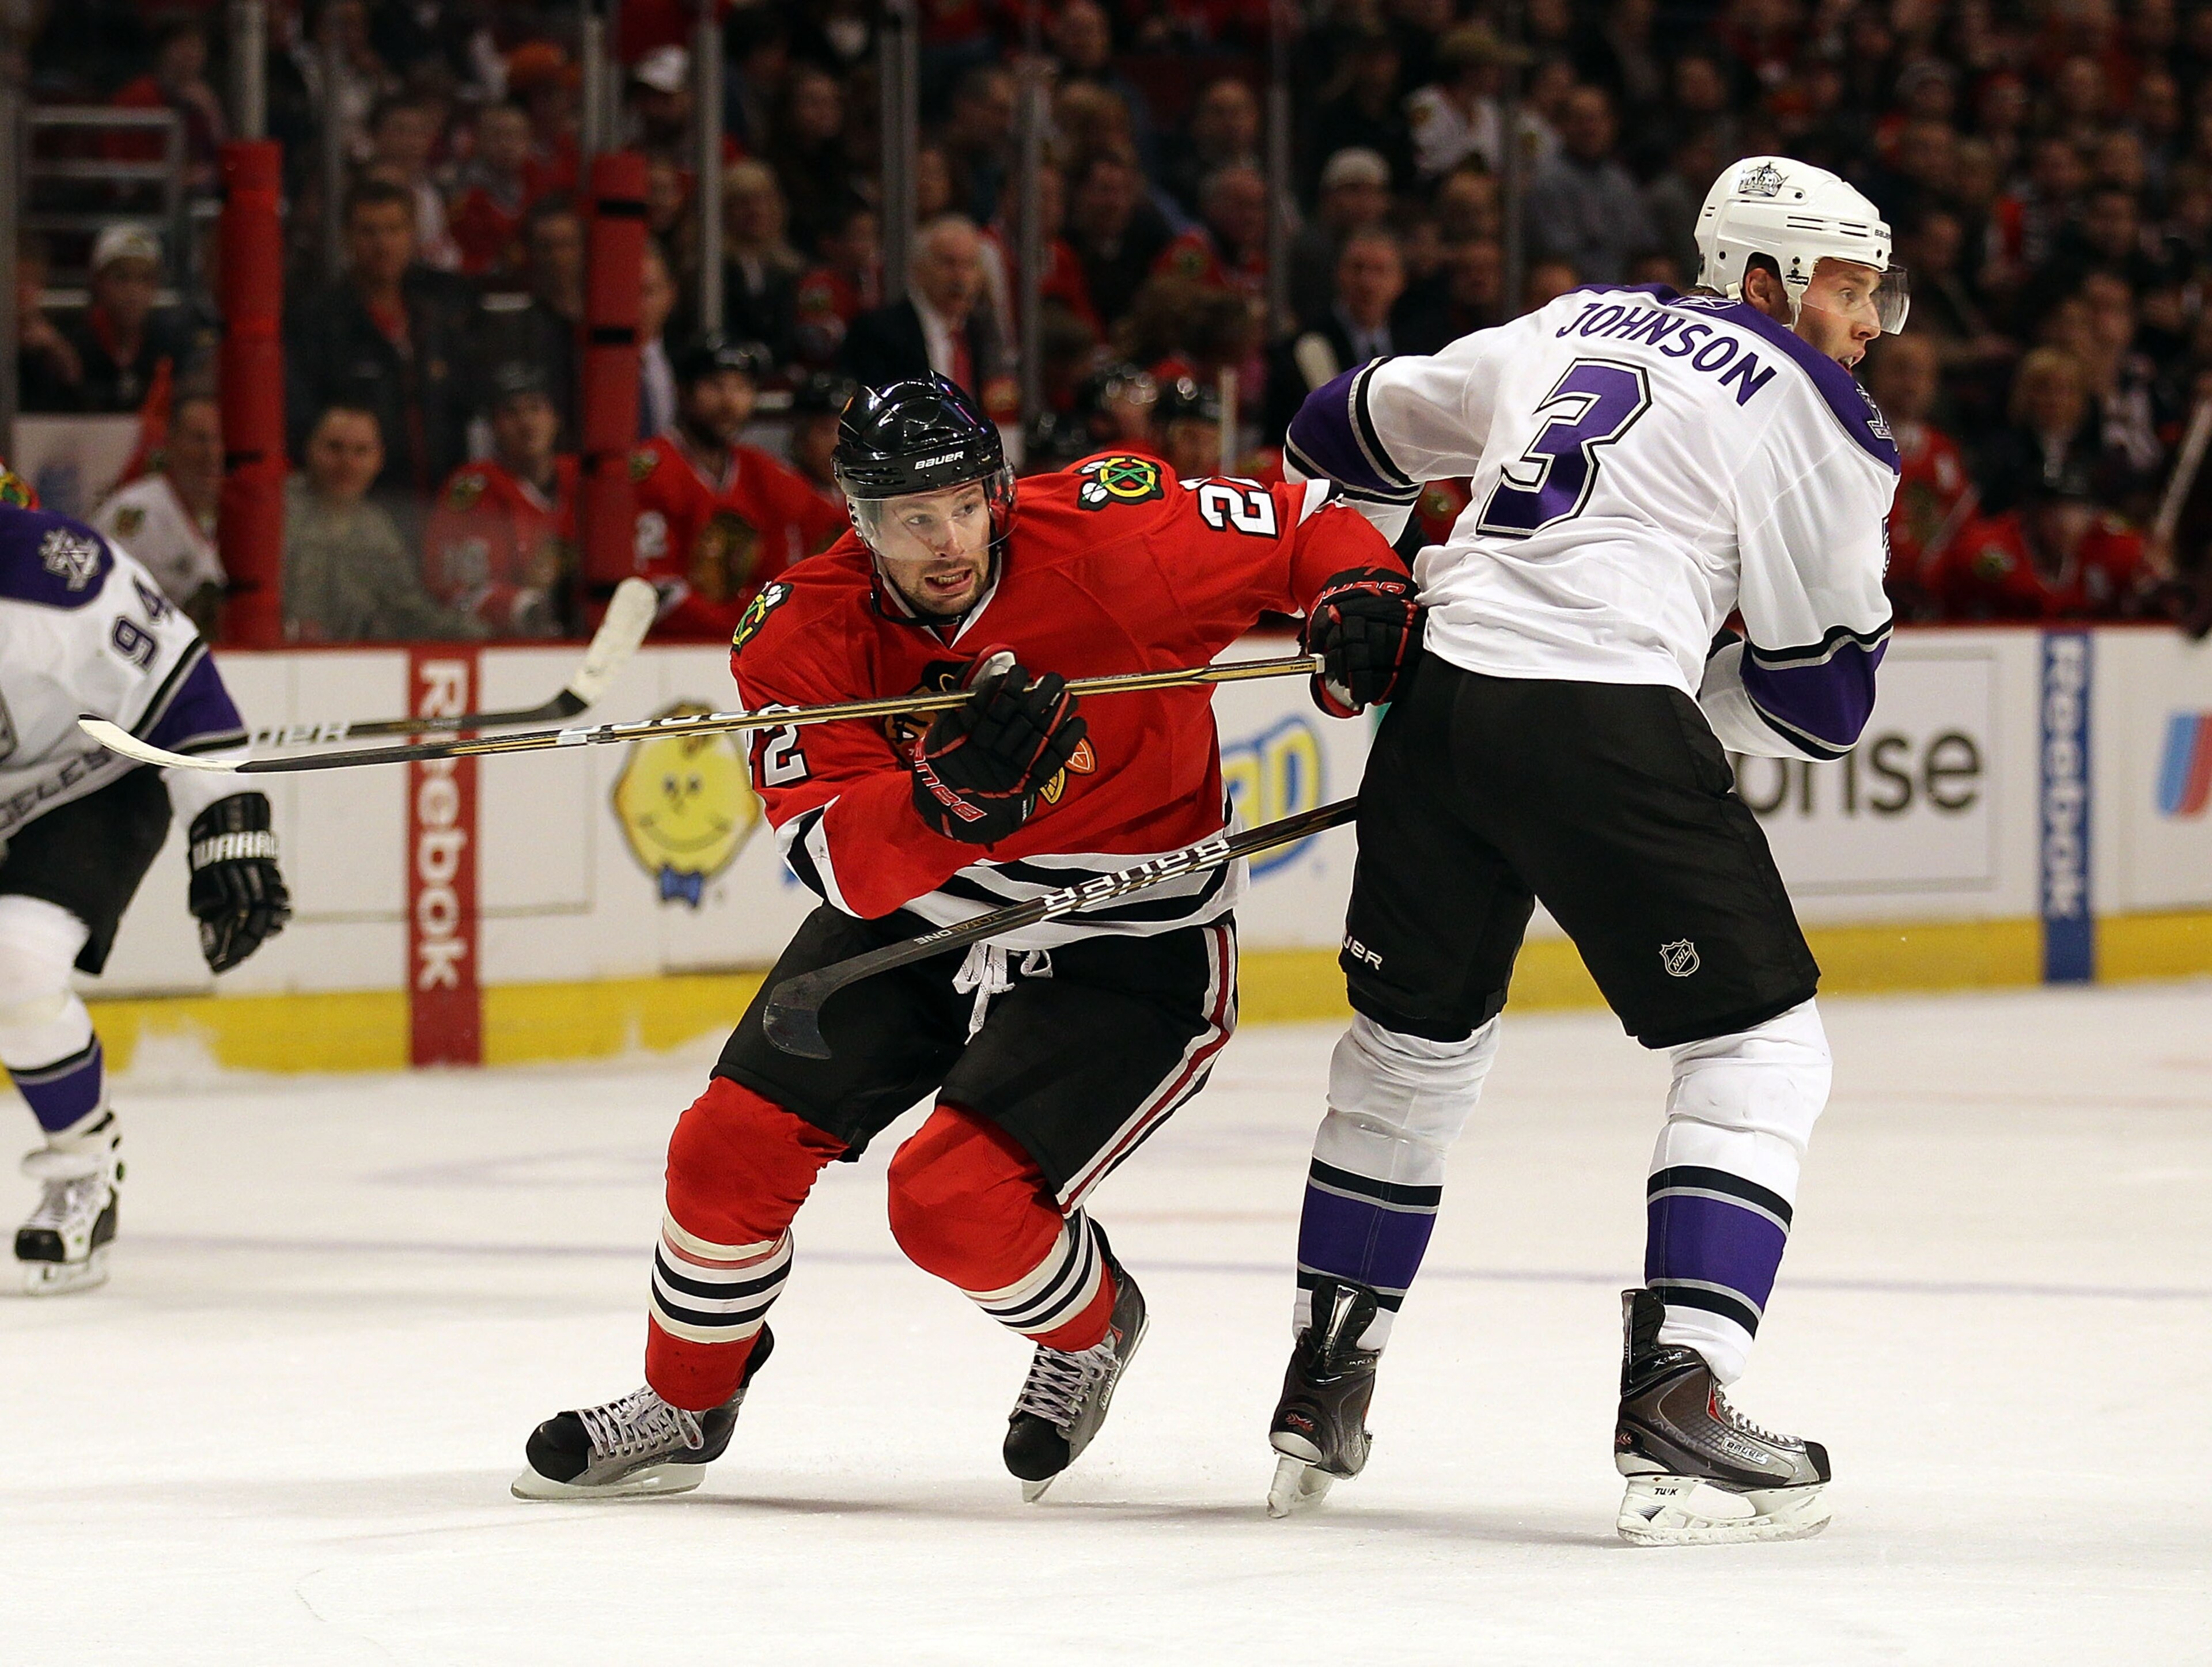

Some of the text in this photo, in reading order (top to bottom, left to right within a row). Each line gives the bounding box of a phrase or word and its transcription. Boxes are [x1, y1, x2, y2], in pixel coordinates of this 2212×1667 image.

[1555, 302, 1778, 407] JOHNSON
[1476, 357, 1653, 537] 3
[2044, 637, 2085, 914] Reebok
[1672, 948, 1690, 971] NHL
